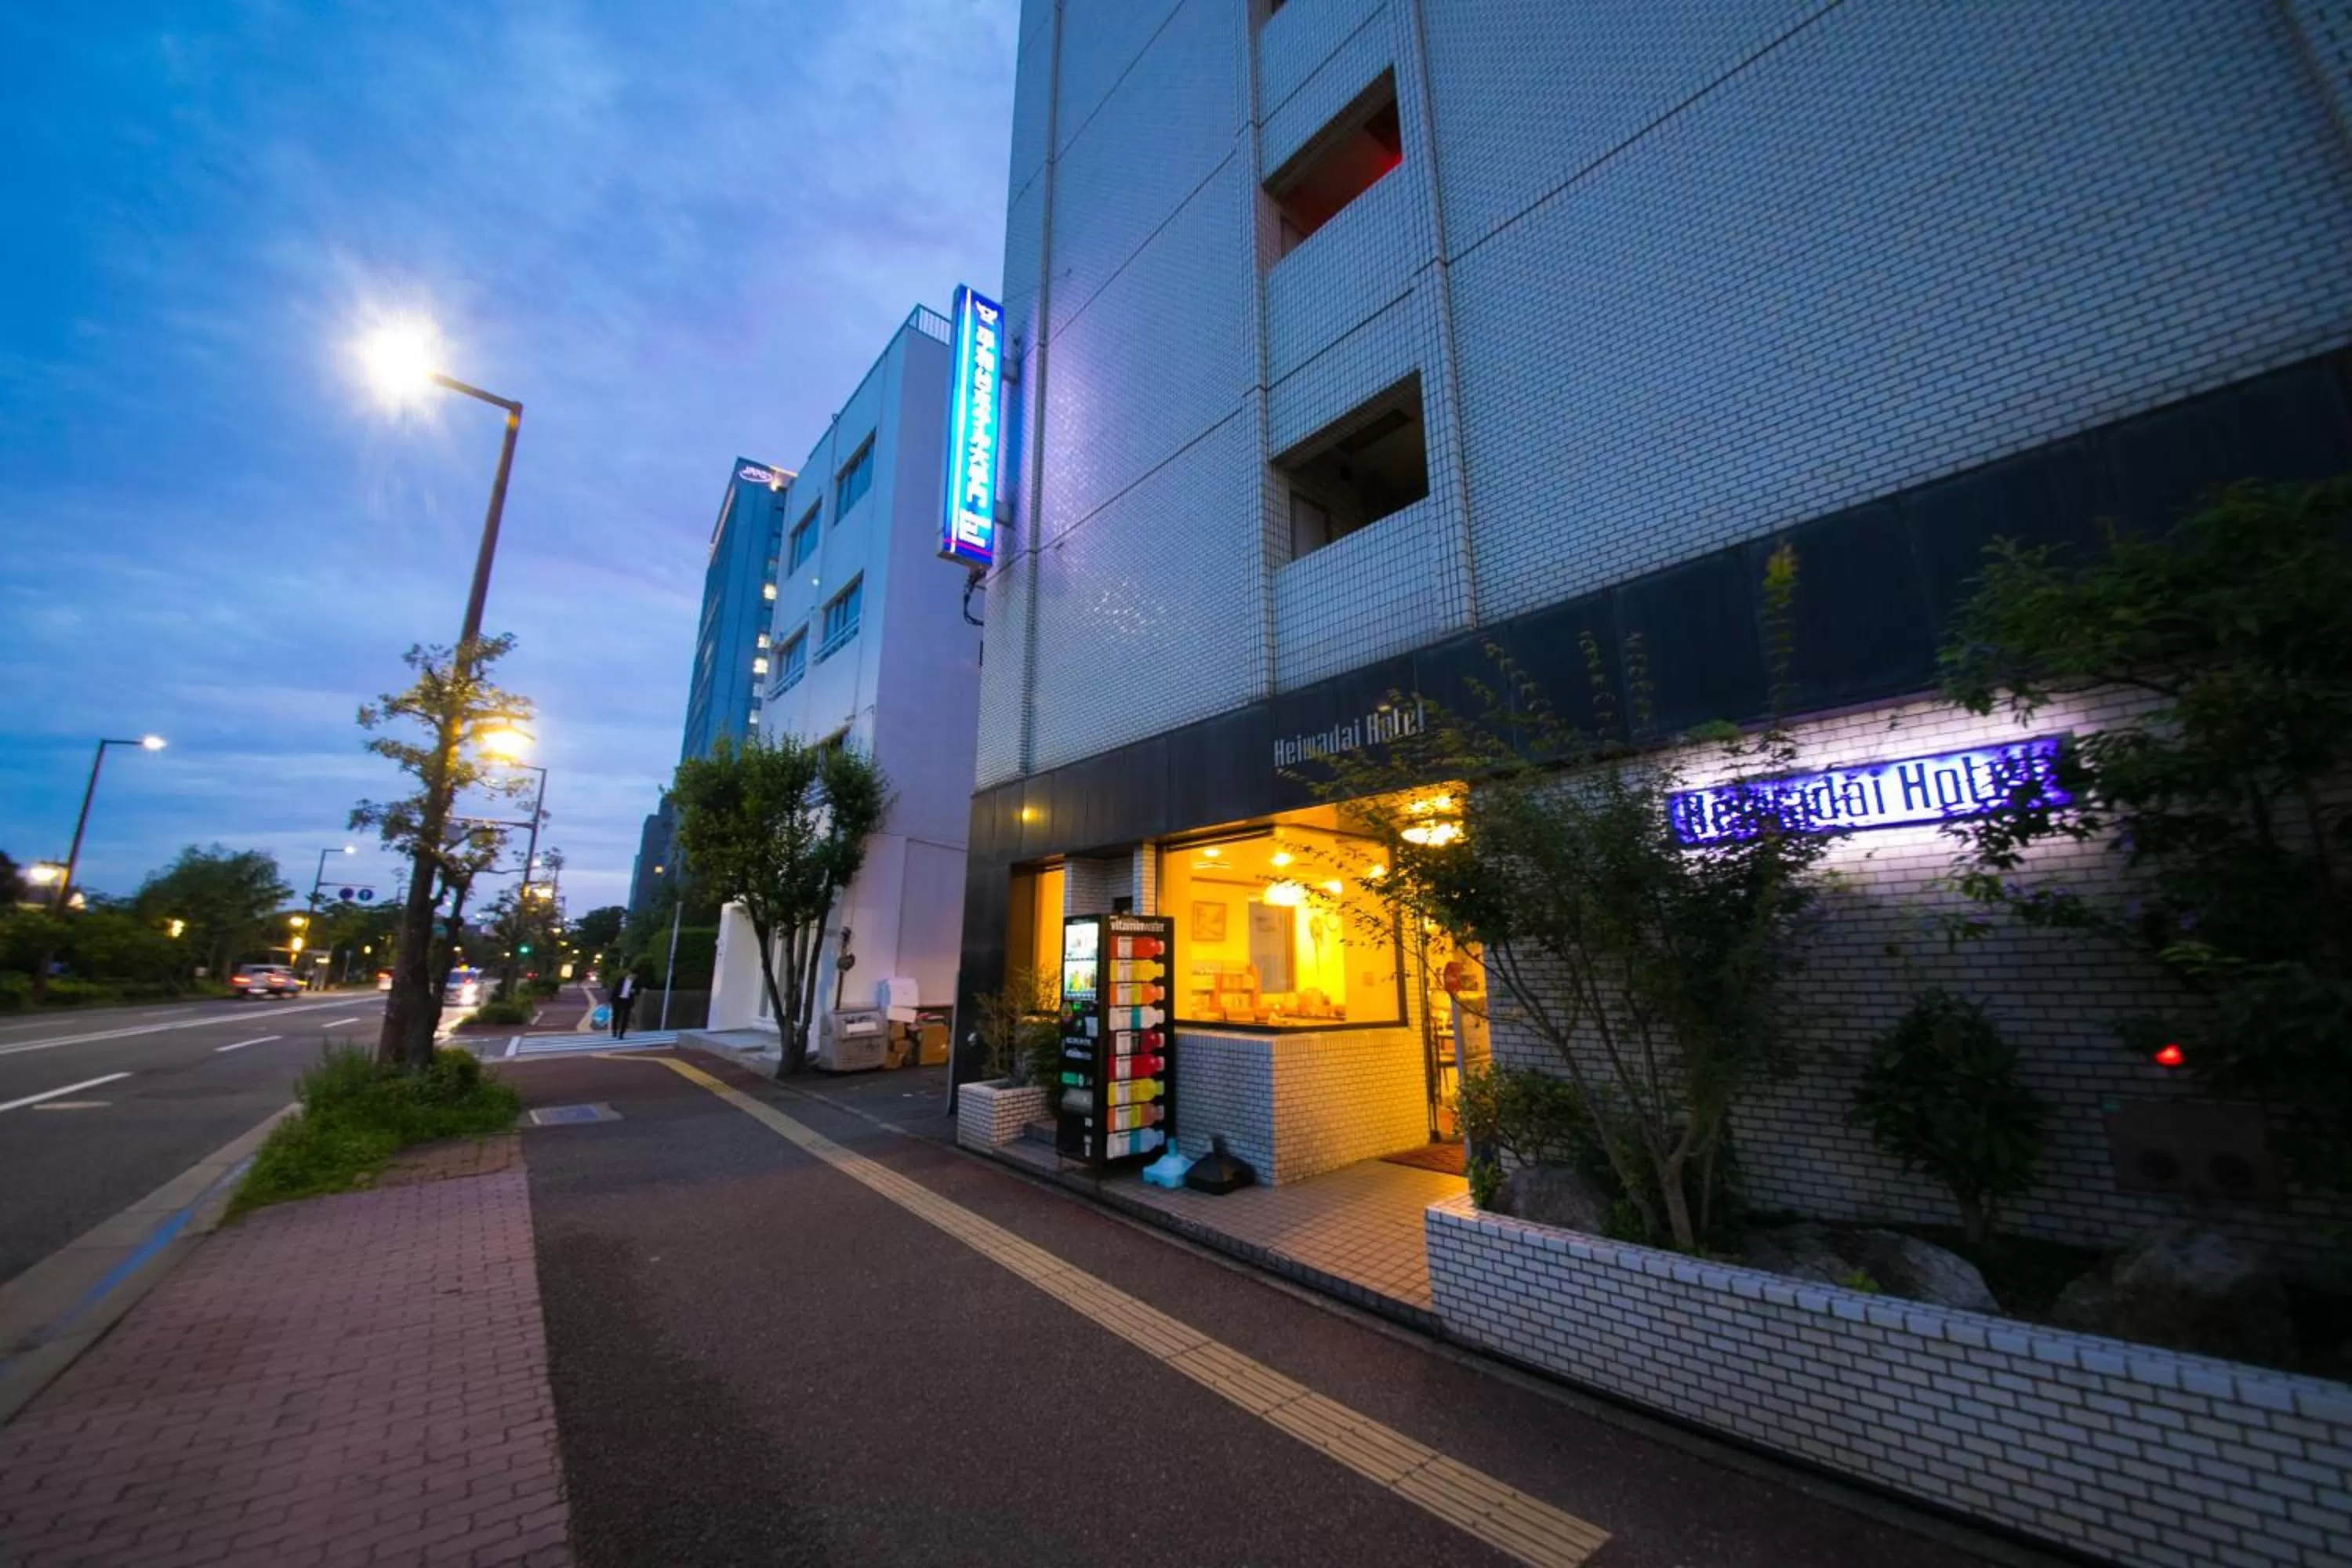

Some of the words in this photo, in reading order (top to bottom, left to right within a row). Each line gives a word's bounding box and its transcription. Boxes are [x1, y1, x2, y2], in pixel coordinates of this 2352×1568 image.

[1274, 718, 1361, 766] Heiwadai
[1367, 702, 1425, 745] Hotel
[1897, 743, 2038, 811] Hot
